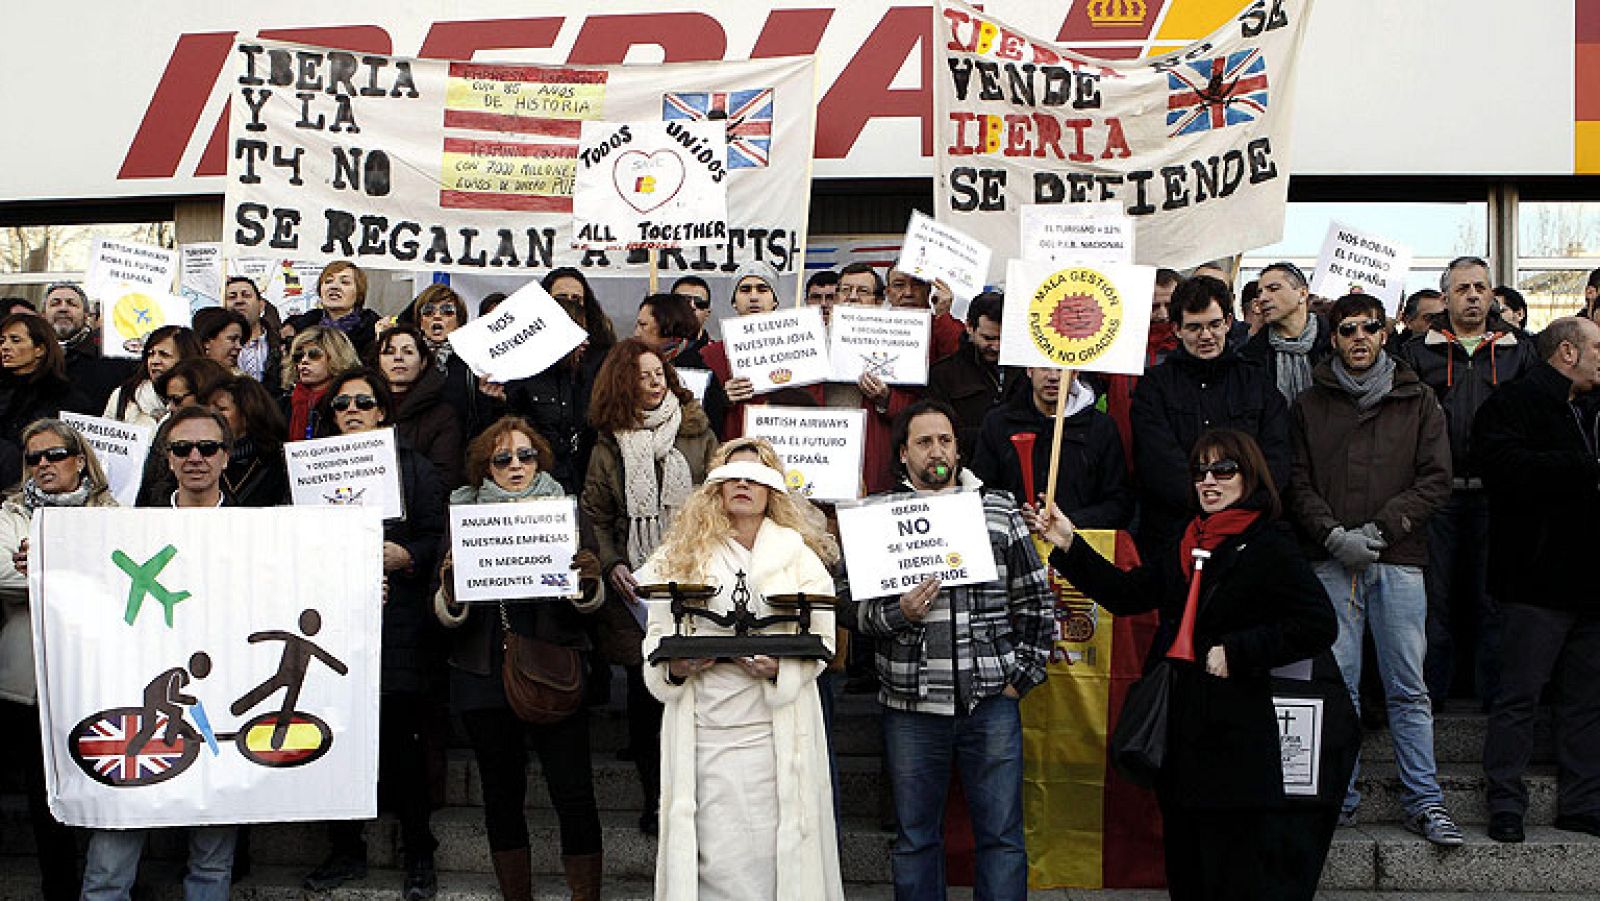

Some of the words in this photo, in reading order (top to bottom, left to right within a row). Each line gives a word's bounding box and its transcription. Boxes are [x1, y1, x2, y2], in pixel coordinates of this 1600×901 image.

[238, 45, 419, 98] IBERIA
[947, 58, 1102, 109] VENDE
[242, 88, 272, 131] Y
[296, 93, 360, 133] LA
[484, 94, 502, 108] DE
[515, 97, 590, 113] HISTORIA
[580, 125, 632, 168] TODOS
[947, 112, 1131, 163] IBERIA
[666, 121, 727, 182] UNIDOS
[235, 138, 305, 186] T4
[332, 147, 390, 196] NO
[949, 166, 1007, 211] SE
[1033, 137, 1277, 216] DEFIENDE
[235, 202, 302, 248] SE
[320, 208, 556, 268] REGALAN
[577, 223, 617, 242] ALL
[637, 221, 726, 240] TOGETHER
[1056, 225, 1096, 234] TURISMO
[1337, 230, 1358, 246] NOS
[1360, 238, 1396, 257] ROBAN
[1329, 262, 1343, 275] DE
[1335, 248, 1345, 259] EL
[1348, 252, 1390, 271] FUTURO
[1035, 275, 1067, 302] MALA
[487, 311, 515, 333] NOS
[743, 323, 755, 334] SE
[758, 317, 799, 332] LLEVAN
[733, 336, 784, 352] NUESTRA
[786, 331, 815, 345] JOYA
[1058, 350, 1076, 362] NO
[1078, 319, 1120, 361] GRACIAS
[737, 356, 751, 368] DE
[754, 356, 767, 365] LA
[770, 348, 817, 363] CORONA
[756, 416, 797, 427] BRITISH
[799, 418, 849, 428] AIRWAYS
[87, 423, 130, 440] RELEGAN
[131, 433, 138, 442] A
[789, 437, 800, 447] EL
[802, 437, 847, 447] FUTURO
[291, 449, 309, 459] NOS
[310, 446, 340, 457] QUITAN
[787, 453, 829, 464] ESPAÑA
[298, 473, 341, 486] NUESTRO
[343, 465, 386, 479] TURISMO
[462, 516, 501, 526] ANULAN
[503, 516, 513, 526] EL
[514, 514, 553, 524] FUTURO
[555, 513, 567, 522] DE
[891, 503, 930, 516] IBERIA
[898, 516, 931, 536] NO
[462, 536, 514, 547] NUESTRAS
[516, 533, 569, 545] EMPRESAS
[887, 543, 903, 553] SE
[479, 558, 492, 568] EN
[495, 554, 553, 566] MERCADOS
[898, 554, 944, 570] IBERIA
[466, 575, 534, 588] EMERGENTES
[880, 577, 899, 590] SE
[902, 567, 968, 587] DEFENDE
